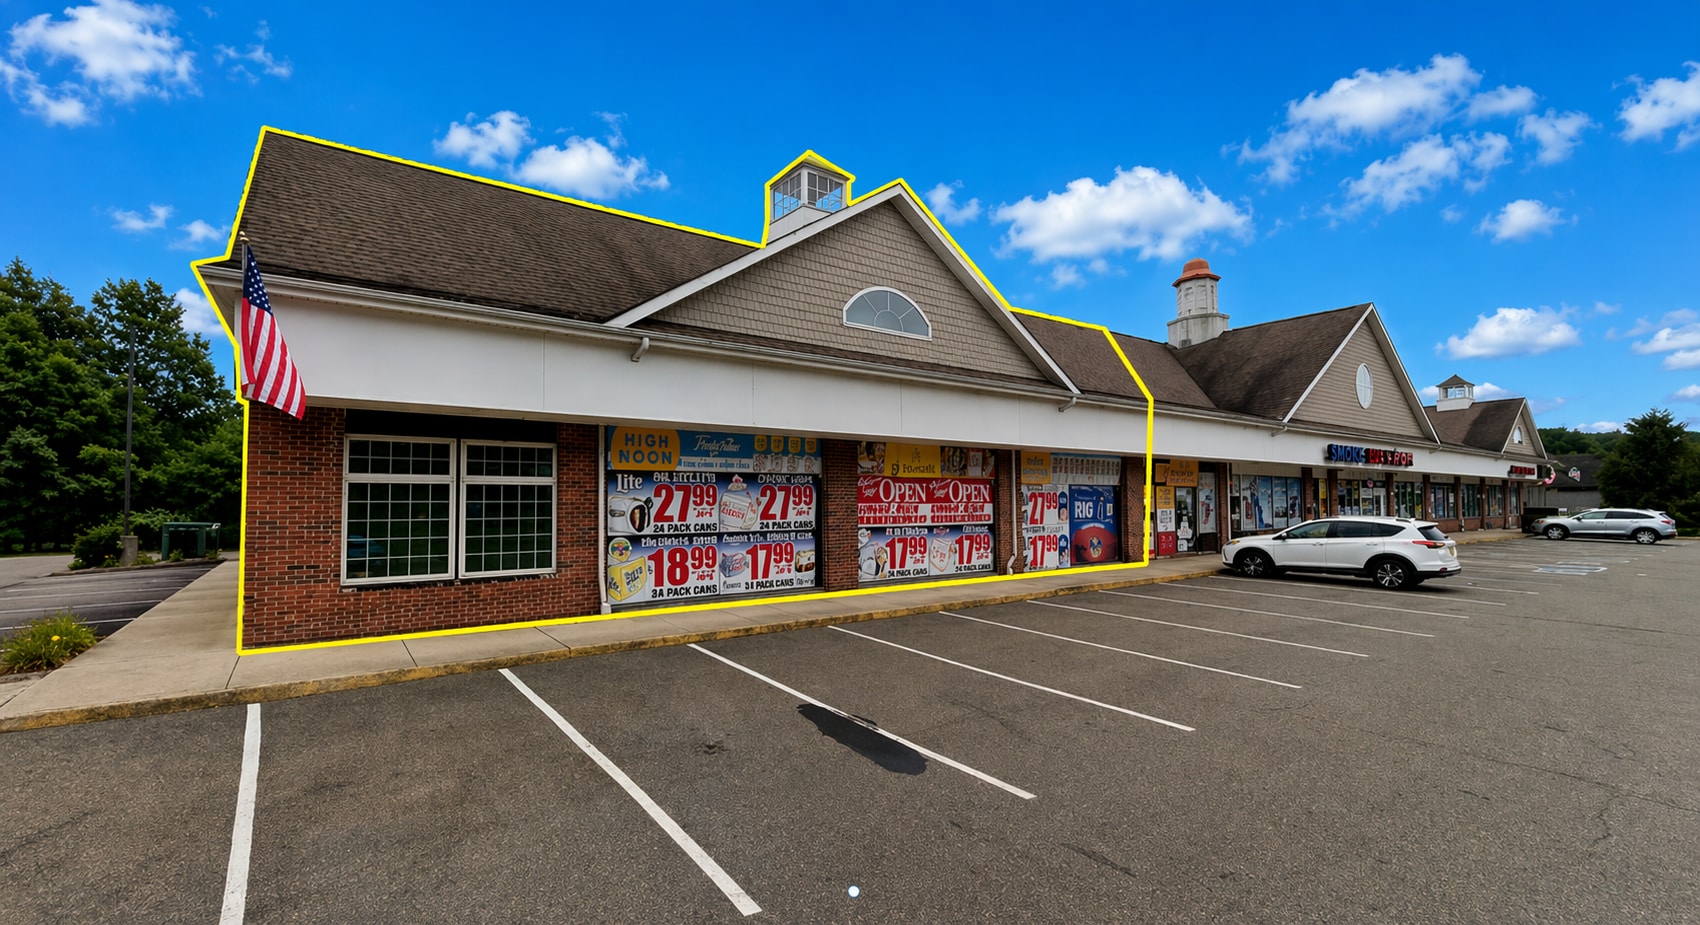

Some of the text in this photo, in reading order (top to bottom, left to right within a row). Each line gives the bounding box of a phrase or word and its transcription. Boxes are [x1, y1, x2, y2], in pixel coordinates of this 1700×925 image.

[625, 433, 669, 449] HIGH
[619, 449, 672, 465] NOON
[615, 473, 643, 494] Lite
[879, 479, 926, 502] OPEN
[949, 480, 990, 502] OPEN
[1074, 501, 1094, 519] RIG
[667, 523, 692, 532] PACK
[666, 586, 691, 597] PACK
